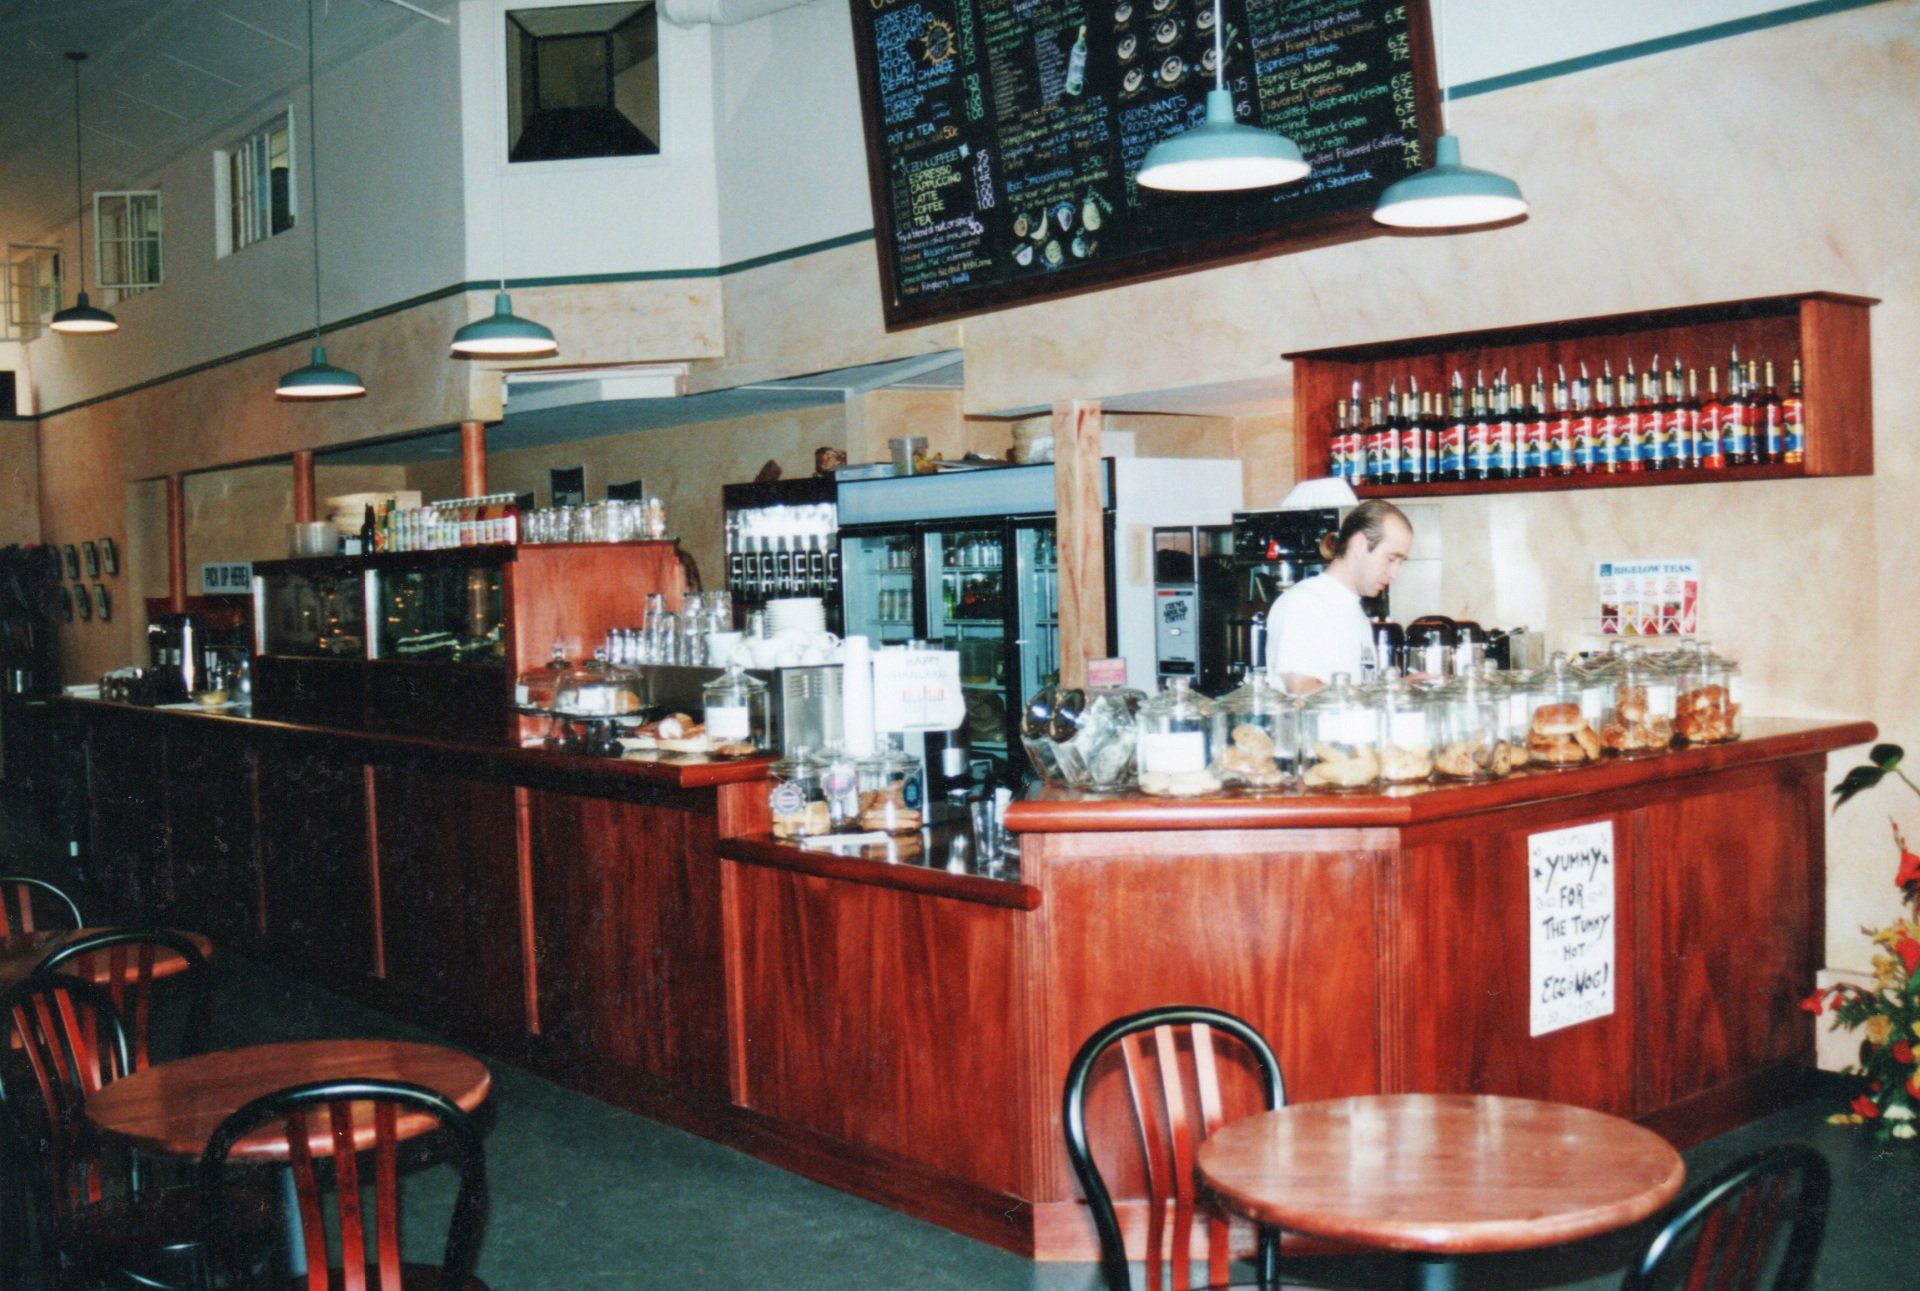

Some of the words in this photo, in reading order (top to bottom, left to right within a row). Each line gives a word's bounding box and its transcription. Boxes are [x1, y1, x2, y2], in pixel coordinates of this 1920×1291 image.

[1313, 15, 1335, 32] Dark
[1337, 8, 1363, 23] Roast
[1255, 51, 1304, 76] Espresso
[1306, 42, 1340, 60] Blends
[881, 75, 915, 95] DEPTH
[917, 58, 956, 81] CHARGE
[1257, 67, 1301, 88] Espresso
[1303, 58, 1333, 74] Nuovo
[1258, 85, 1287, 100] Decaf
[1290, 70, 1336, 92] Espresso
[883, 94, 925, 114] TURKISH
[1118, 93, 1188, 125] CROISSANTS
[1258, 93, 1303, 112] Flavored
[1308, 91, 1360, 112] Raspberry
[885, 108, 916, 126] HOUSE
[1120, 109, 1181, 137] CROISSANT
[1338, 115, 1369, 132] Cream
[887, 131, 904, 145] POT
[916, 122, 936, 137] TEA
[1318, 134, 1349, 149] Cream
[925, 149, 960, 169] COFFEE
[1335, 144, 1371, 161] Flavored
[909, 164, 953, 186] ESPRESSO
[910, 171, 962, 195] CAPPUCCINO
[1326, 168, 1374, 188] Shamrock
[912, 190, 939, 208] LATTE
[912, 200, 946, 216] COFFEE
[914, 213, 933, 226] TEA
[1613, 565, 1660, 575] BIGELOW
[1663, 564, 1693, 574] TEAS
[1545, 848, 1603, 893] YUMMY
[1560, 883, 1585, 910] FOR
[1542, 916, 1566, 941] THE
[1571, 914, 1611, 941] TUMMY
[1563, 943, 1586, 961] HOT
